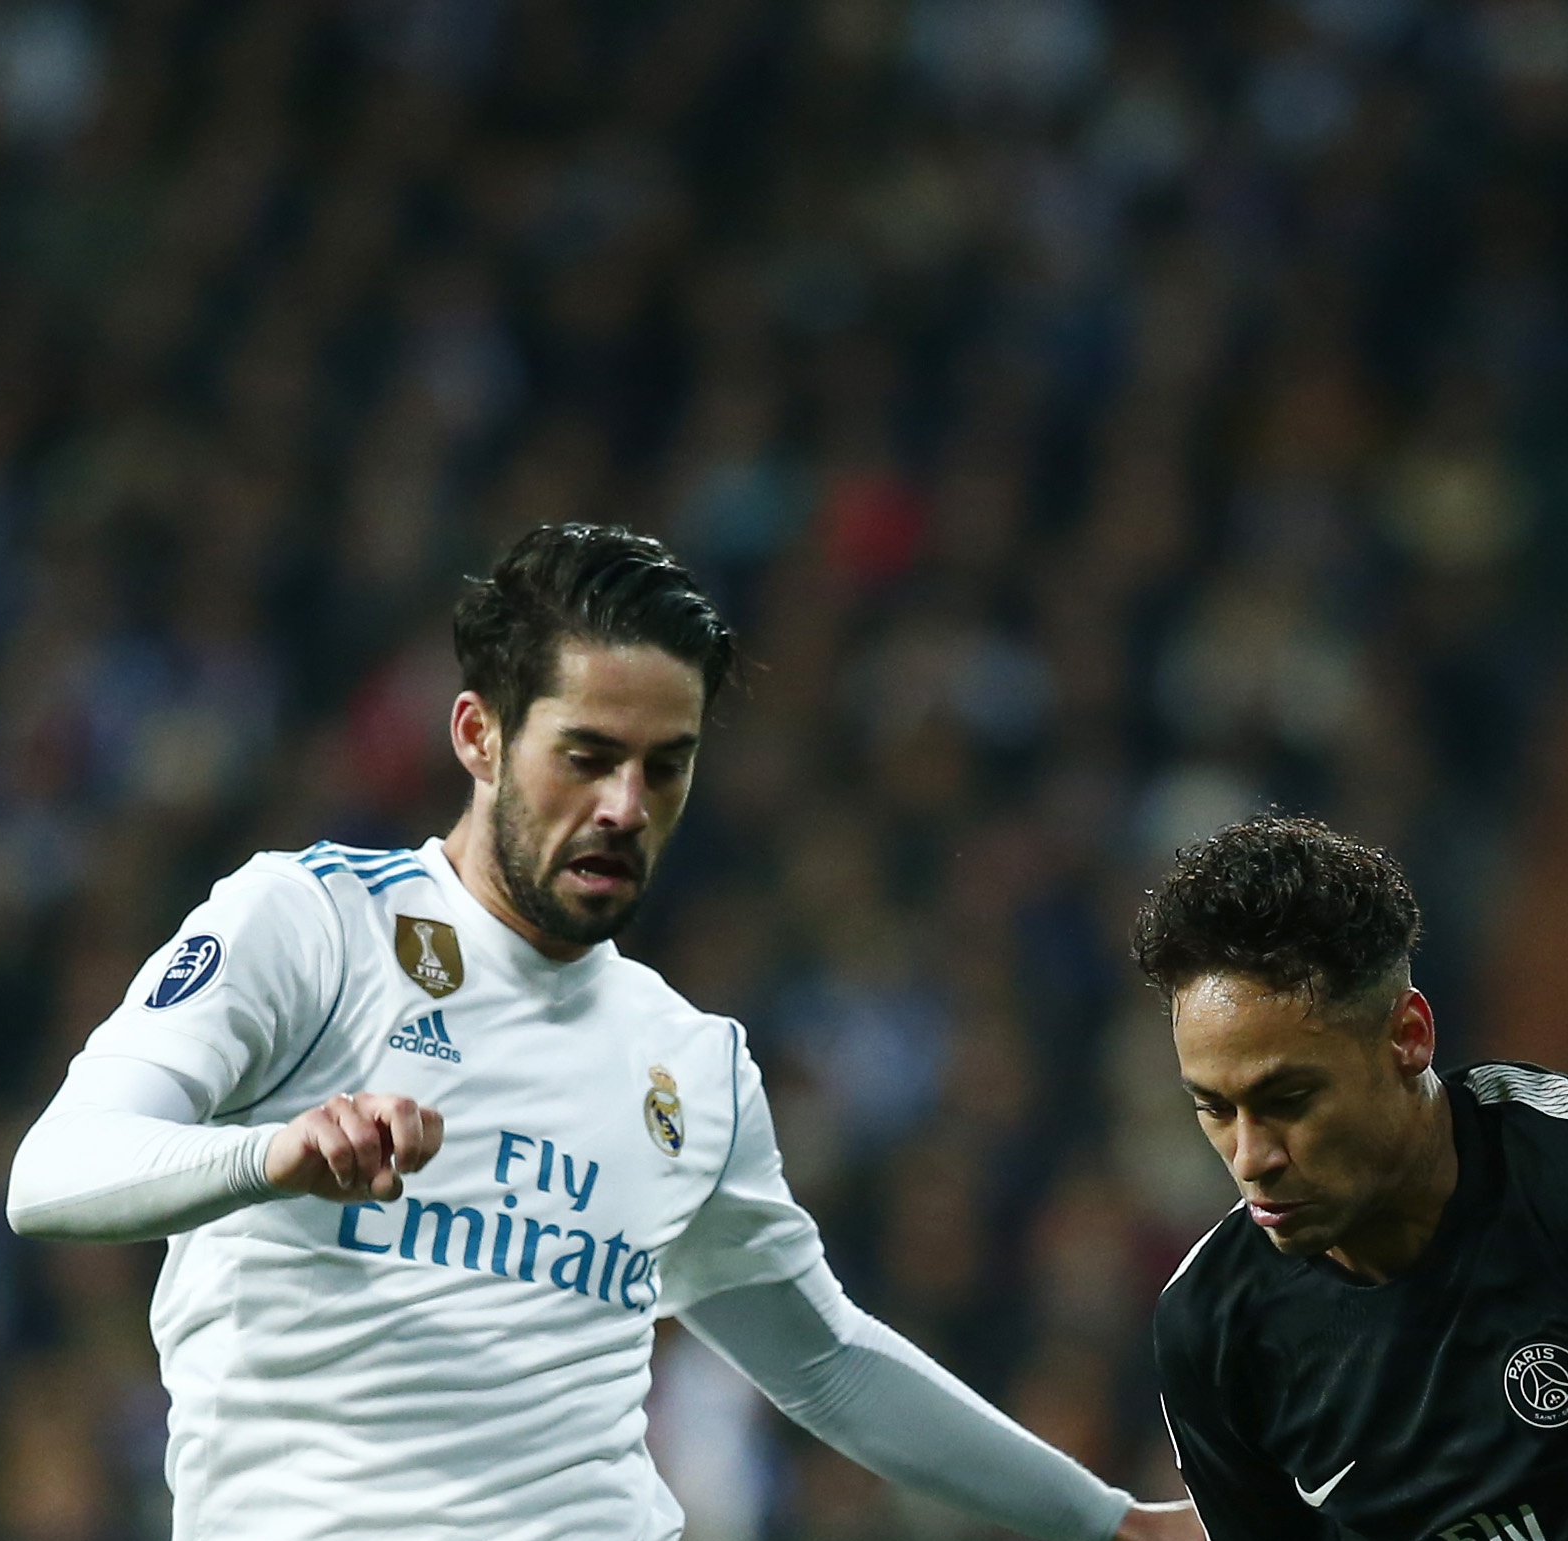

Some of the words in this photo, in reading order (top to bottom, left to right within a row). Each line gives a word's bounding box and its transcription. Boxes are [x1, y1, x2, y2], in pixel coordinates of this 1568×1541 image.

[416, 963, 450, 982] FIFA
[389, 1034, 462, 1064] adidas
[494, 1130, 599, 1212] Fly
[1508, 1347, 1555, 1380] PARIS
